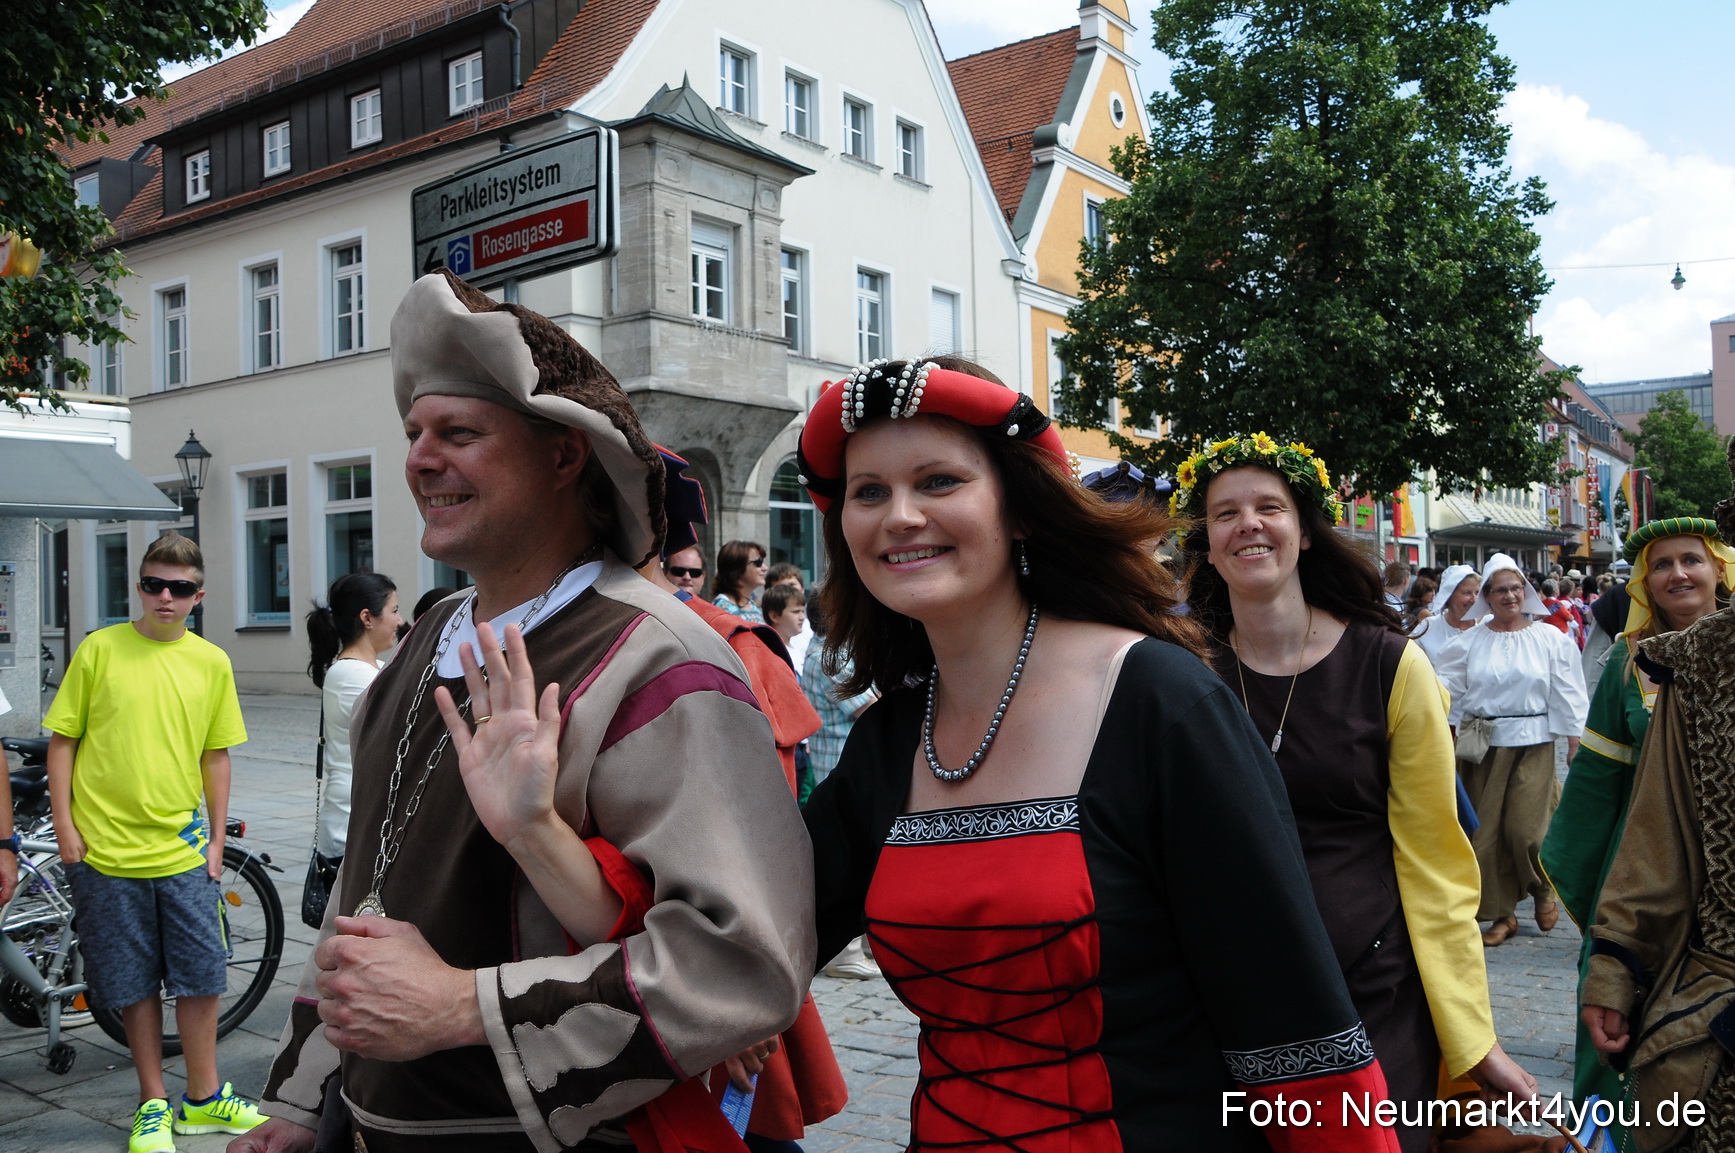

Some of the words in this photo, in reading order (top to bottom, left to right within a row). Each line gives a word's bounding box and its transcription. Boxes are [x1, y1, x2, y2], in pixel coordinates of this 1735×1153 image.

[440, 162, 561, 222] Parkleitsystem
[454, 254, 465, 273] P
[481, 218, 563, 259] Rosengasse
